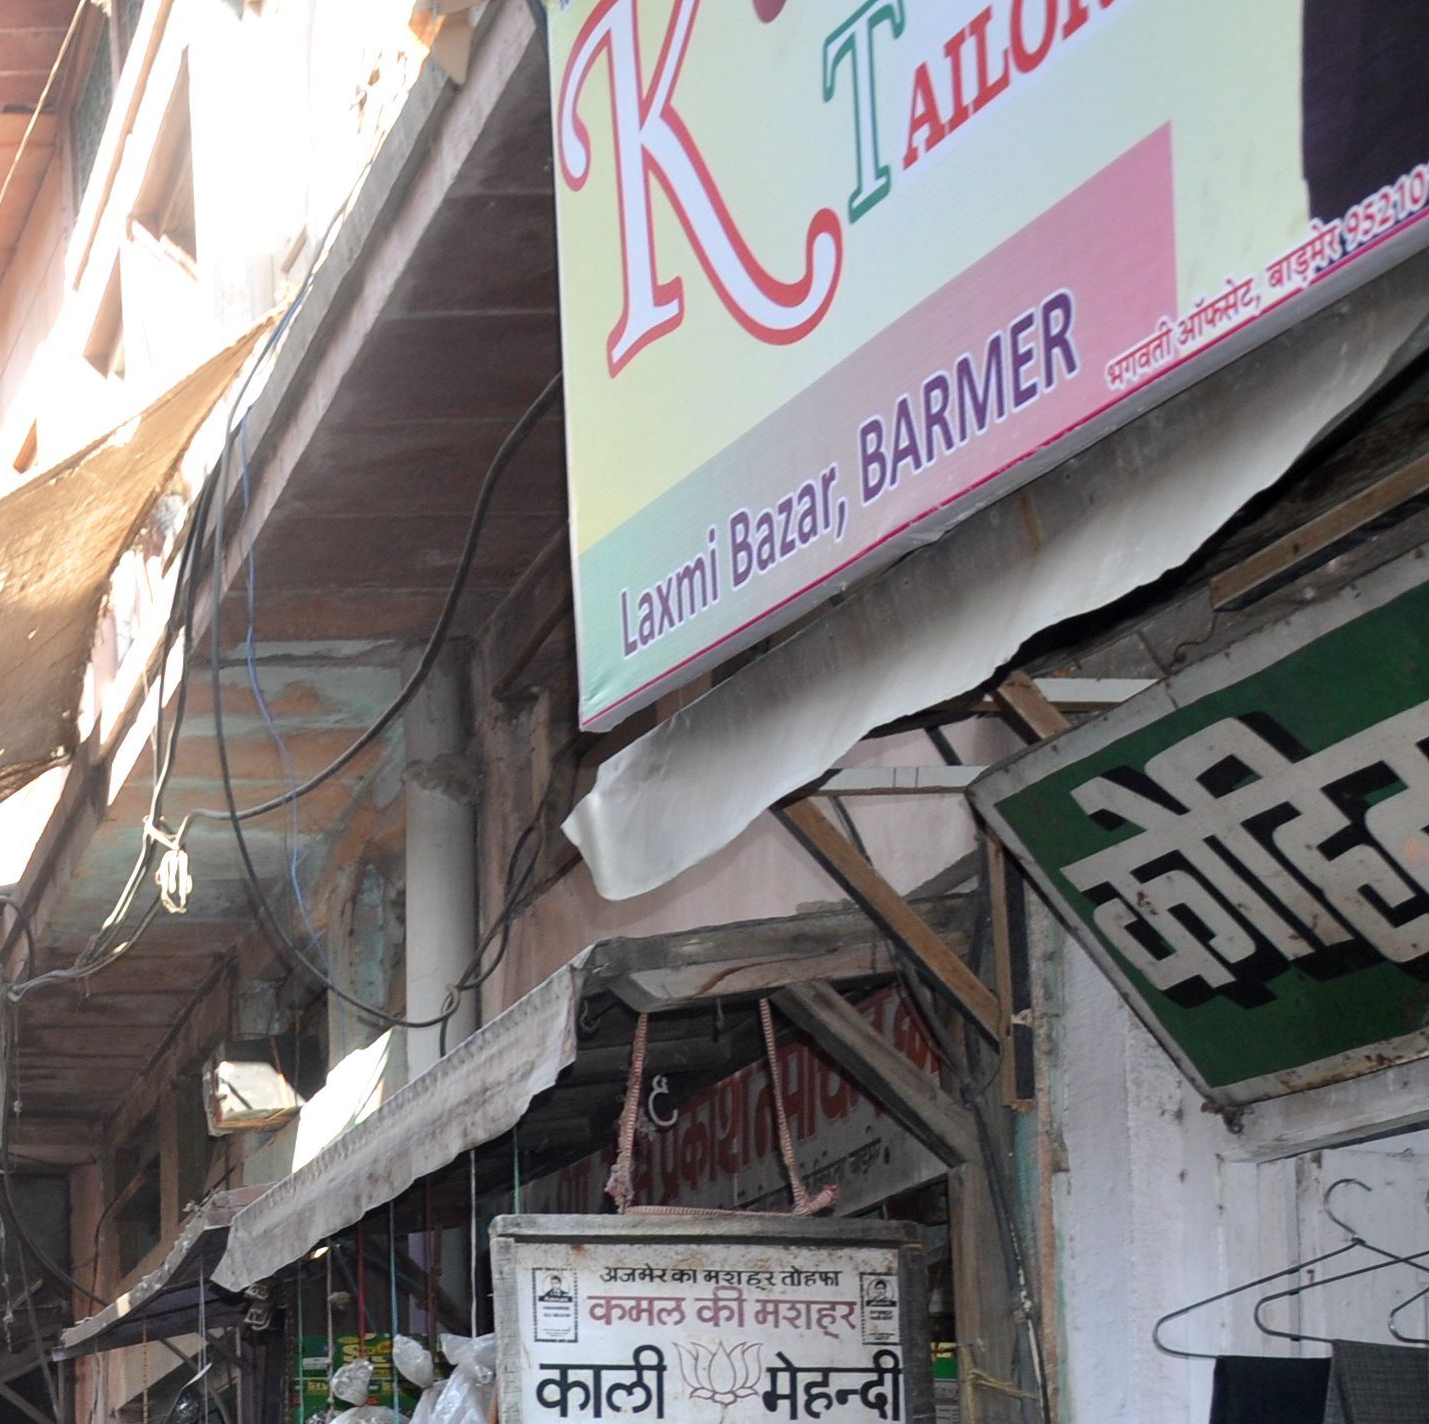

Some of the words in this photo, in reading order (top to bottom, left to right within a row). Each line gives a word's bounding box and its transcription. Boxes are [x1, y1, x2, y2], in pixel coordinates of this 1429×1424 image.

[823, 0, 1117, 224] TAILO
[1107, 320, 1172, 386] भगवती
[1265, 223, 1340, 286] बाड़मेर
[1345, 164, 1429, 247] 95210
[622, 536, 719, 657] Laxmi
[730, 467, 848, 588] Bazar,
[859, 290, 1079, 506] BARMER
[587, 1295, 686, 1326] कमल
[693, 1285, 748, 1328] की
[599, 1263, 668, 1284] अजमेर
[669, 1267, 698, 1285] का
[778, 1265, 843, 1287] तोहफा
[536, 1344, 667, 1419] काली
[762, 1348, 905, 1421] मेहन्दी
